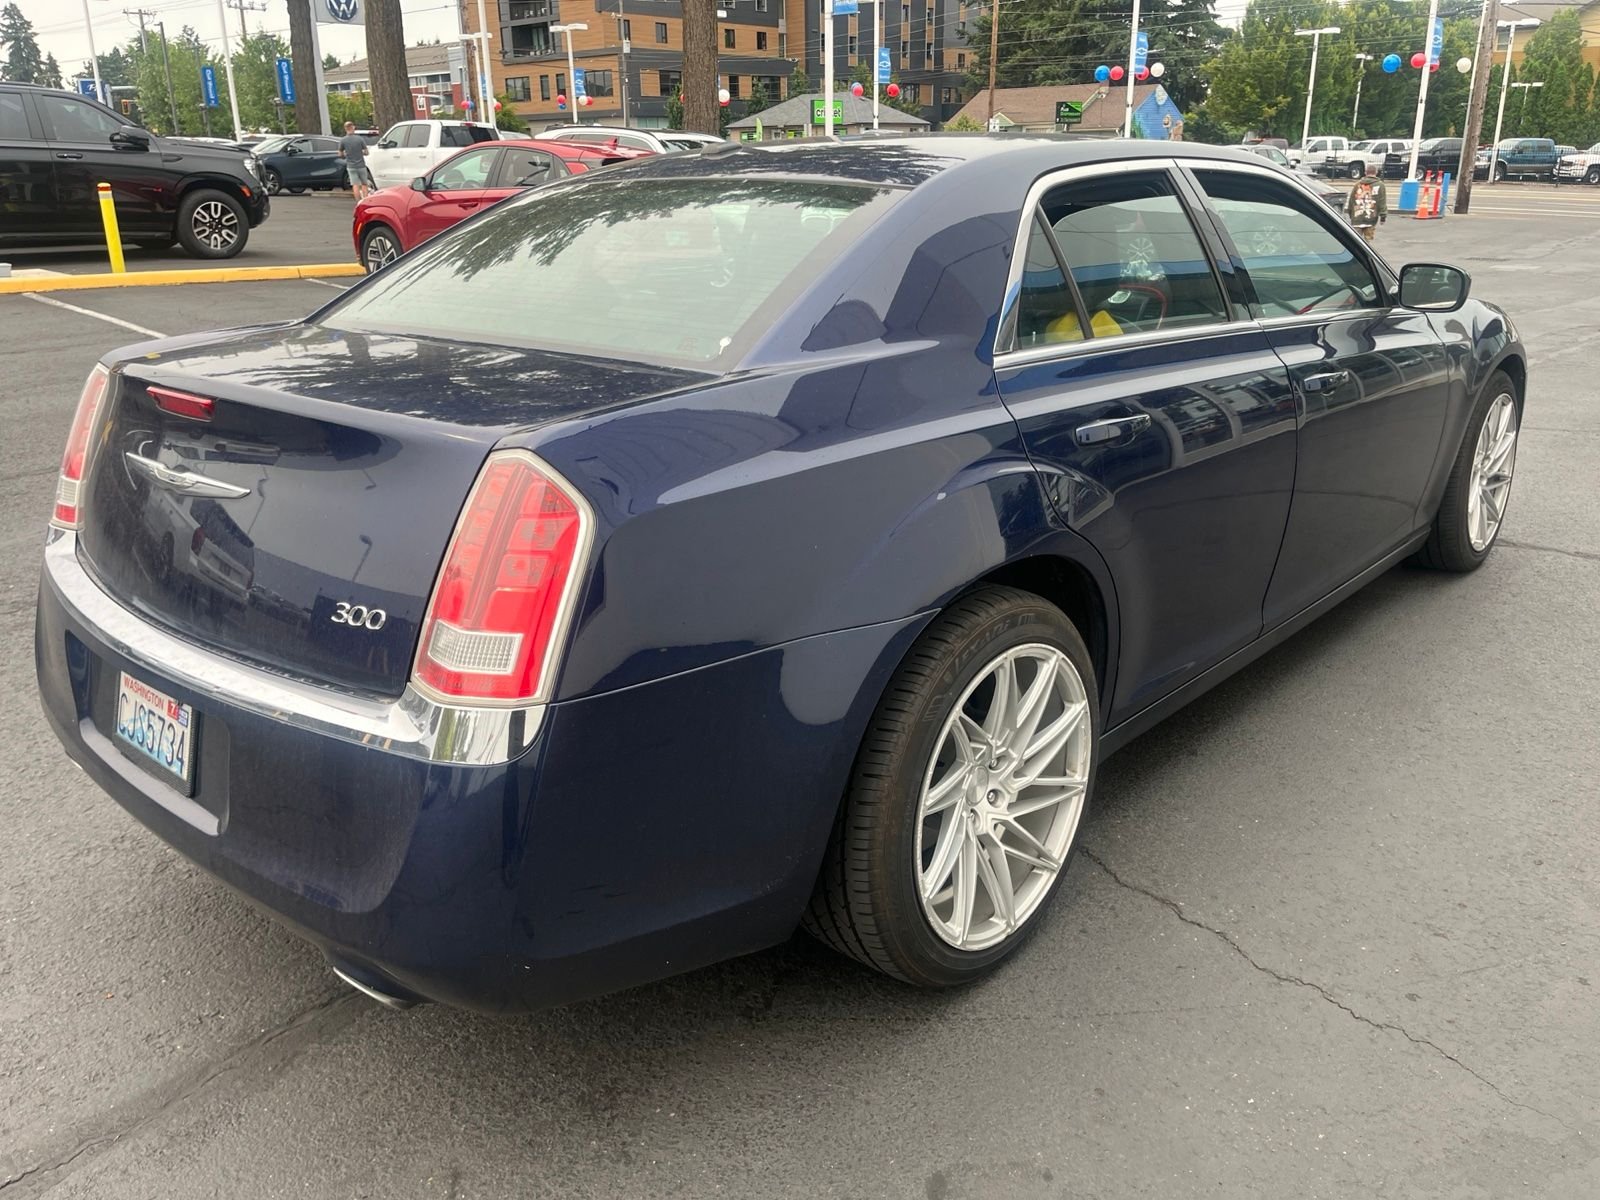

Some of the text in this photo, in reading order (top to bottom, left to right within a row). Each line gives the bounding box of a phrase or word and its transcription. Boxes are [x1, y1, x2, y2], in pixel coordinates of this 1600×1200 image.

[816, 108, 841, 117] criet
[330, 601, 387, 630] 300
[123, 676, 164, 710] WASHINGTON
[119, 692, 185, 774] CJS5734
